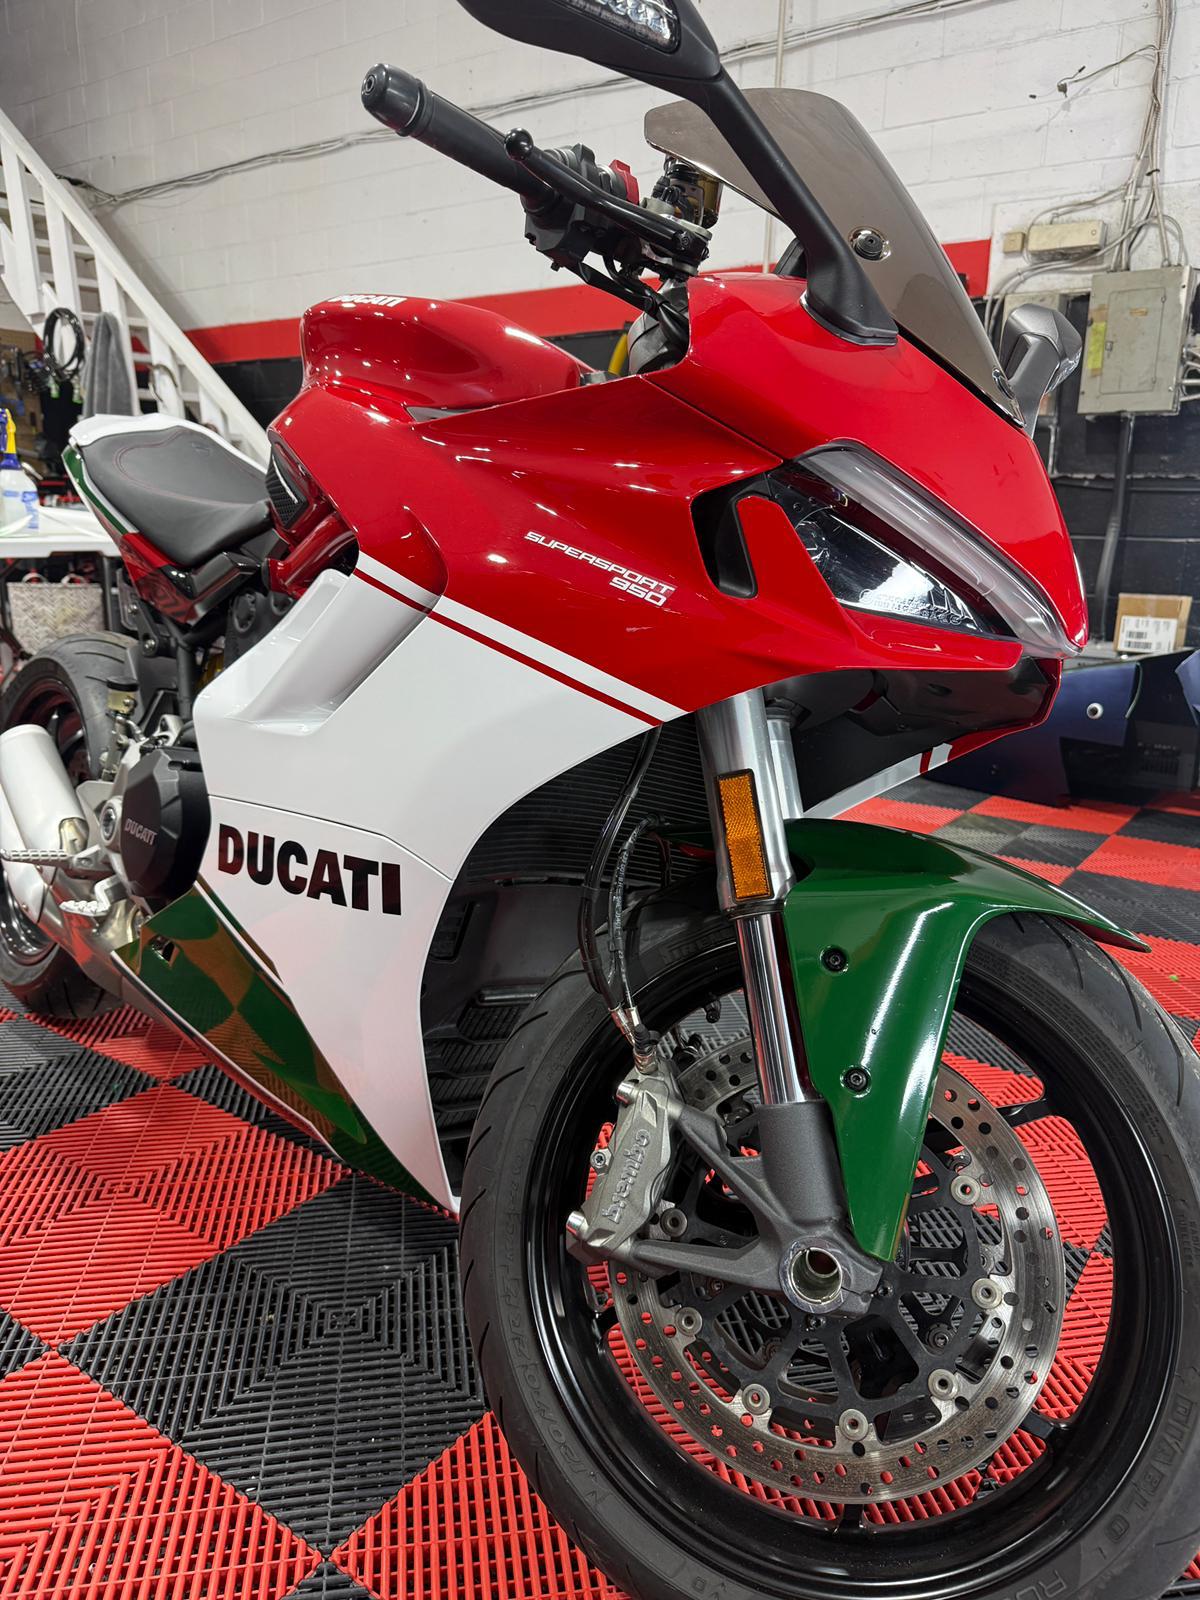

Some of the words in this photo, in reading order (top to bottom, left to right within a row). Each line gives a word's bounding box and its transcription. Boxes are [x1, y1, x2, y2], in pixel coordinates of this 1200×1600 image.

[524, 531, 677, 594] SUPERSPORT
[609, 576, 667, 607] 950
[124, 818, 157, 846] DUCATI
[218, 823, 402, 916] DUCATI
[602, 1128, 650, 1224] brembo
